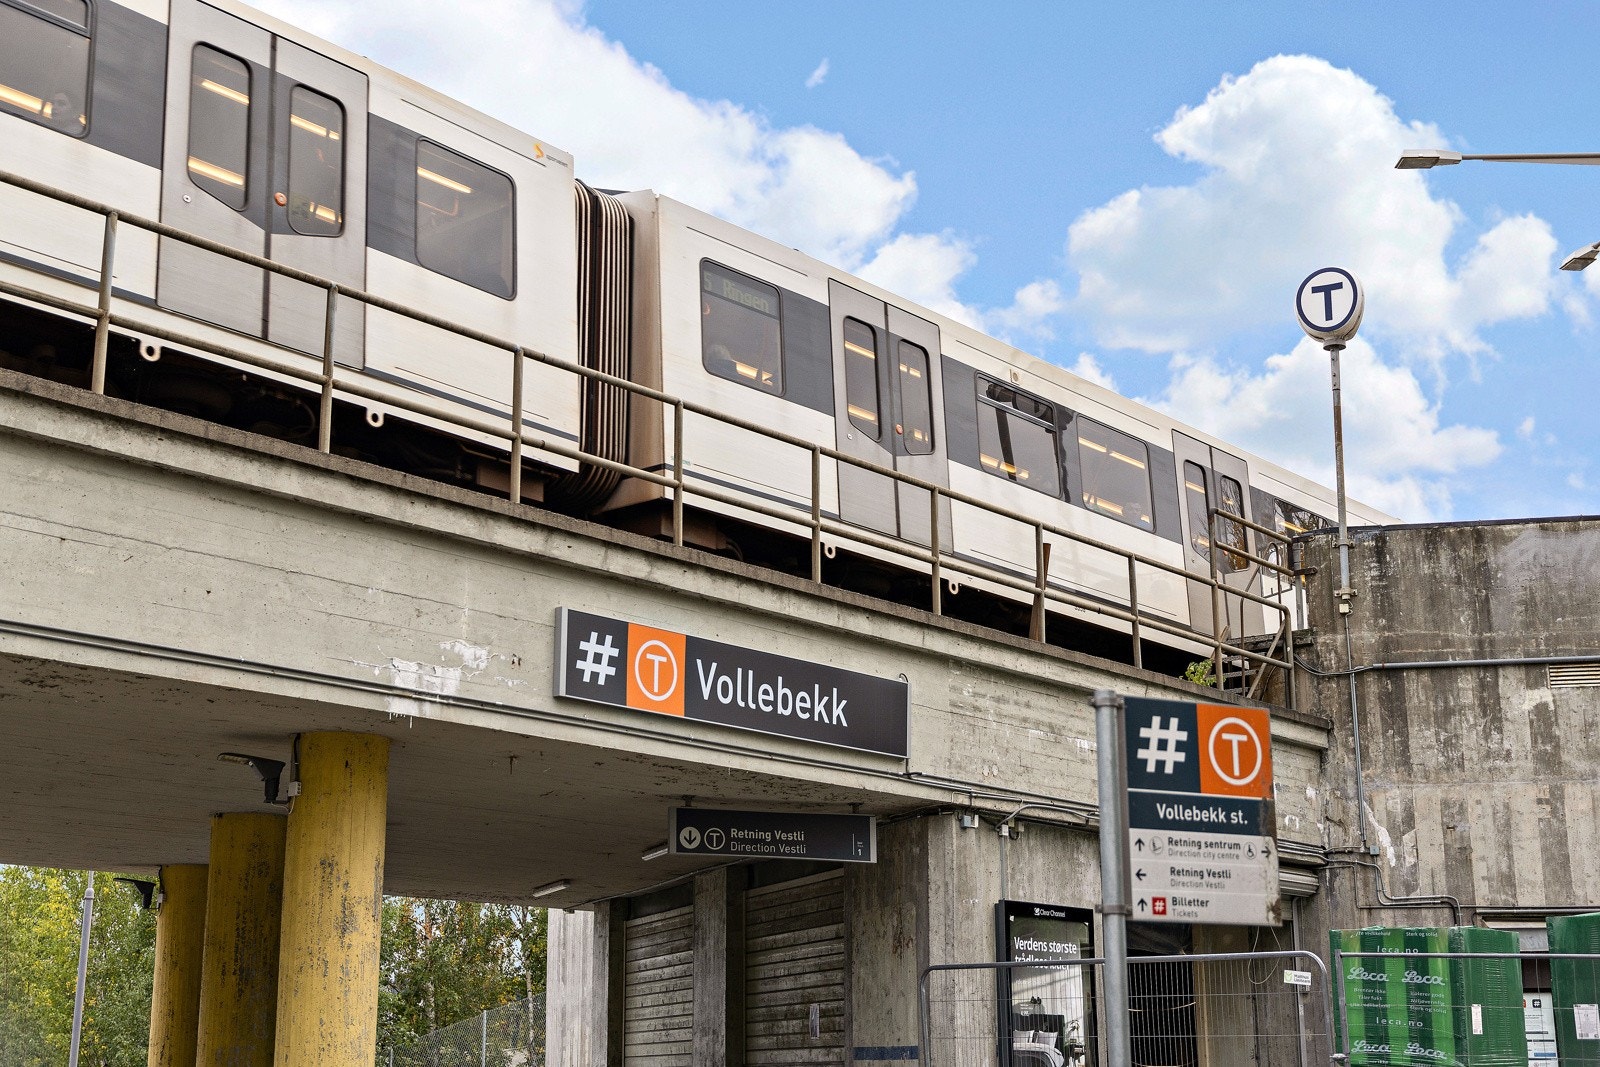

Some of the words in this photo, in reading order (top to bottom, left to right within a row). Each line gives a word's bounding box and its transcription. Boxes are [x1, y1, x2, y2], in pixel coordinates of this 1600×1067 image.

[723, 279, 769, 313] Ringen
[1311, 281, 1343, 321] T
[696, 658, 848, 727] Vollebekk
[1156, 803, 1227, 823] Vollebekk
[1230, 809, 1248, 824] st.
[730, 828, 771, 841] Retning
[774, 830, 805, 841] Vestli
[730, 842, 776, 853] Direction
[779, 844, 806, 854] Vestli
[1167, 837, 1201, 849] Retning
[1204, 840, 1241, 850] sentrum
[1168, 849, 1200, 858] Direction
[1203, 850, 1216, 860] city
[1217, 852, 1240, 860] centre
[1170, 866, 1204, 879] Retning
[1206, 868, 1231, 879] Vestli
[1170, 879, 1204, 888] Direction
[1205, 881, 1225, 889] Vestli
[1171, 896, 1209, 908] Billetter
[1172, 908, 1198, 917] Tickets
[1014, 936, 1048, 952] Verdens
[1049, 941, 1077, 954] største
[1346, 966, 1389, 982] Leca
[1401, 970, 1446, 986] Leca
[1376, 1016, 1423, 1027] leca.no
[1351, 1040, 1391, 1053] Leca
[1403, 1041, 1447, 1060] Leca
